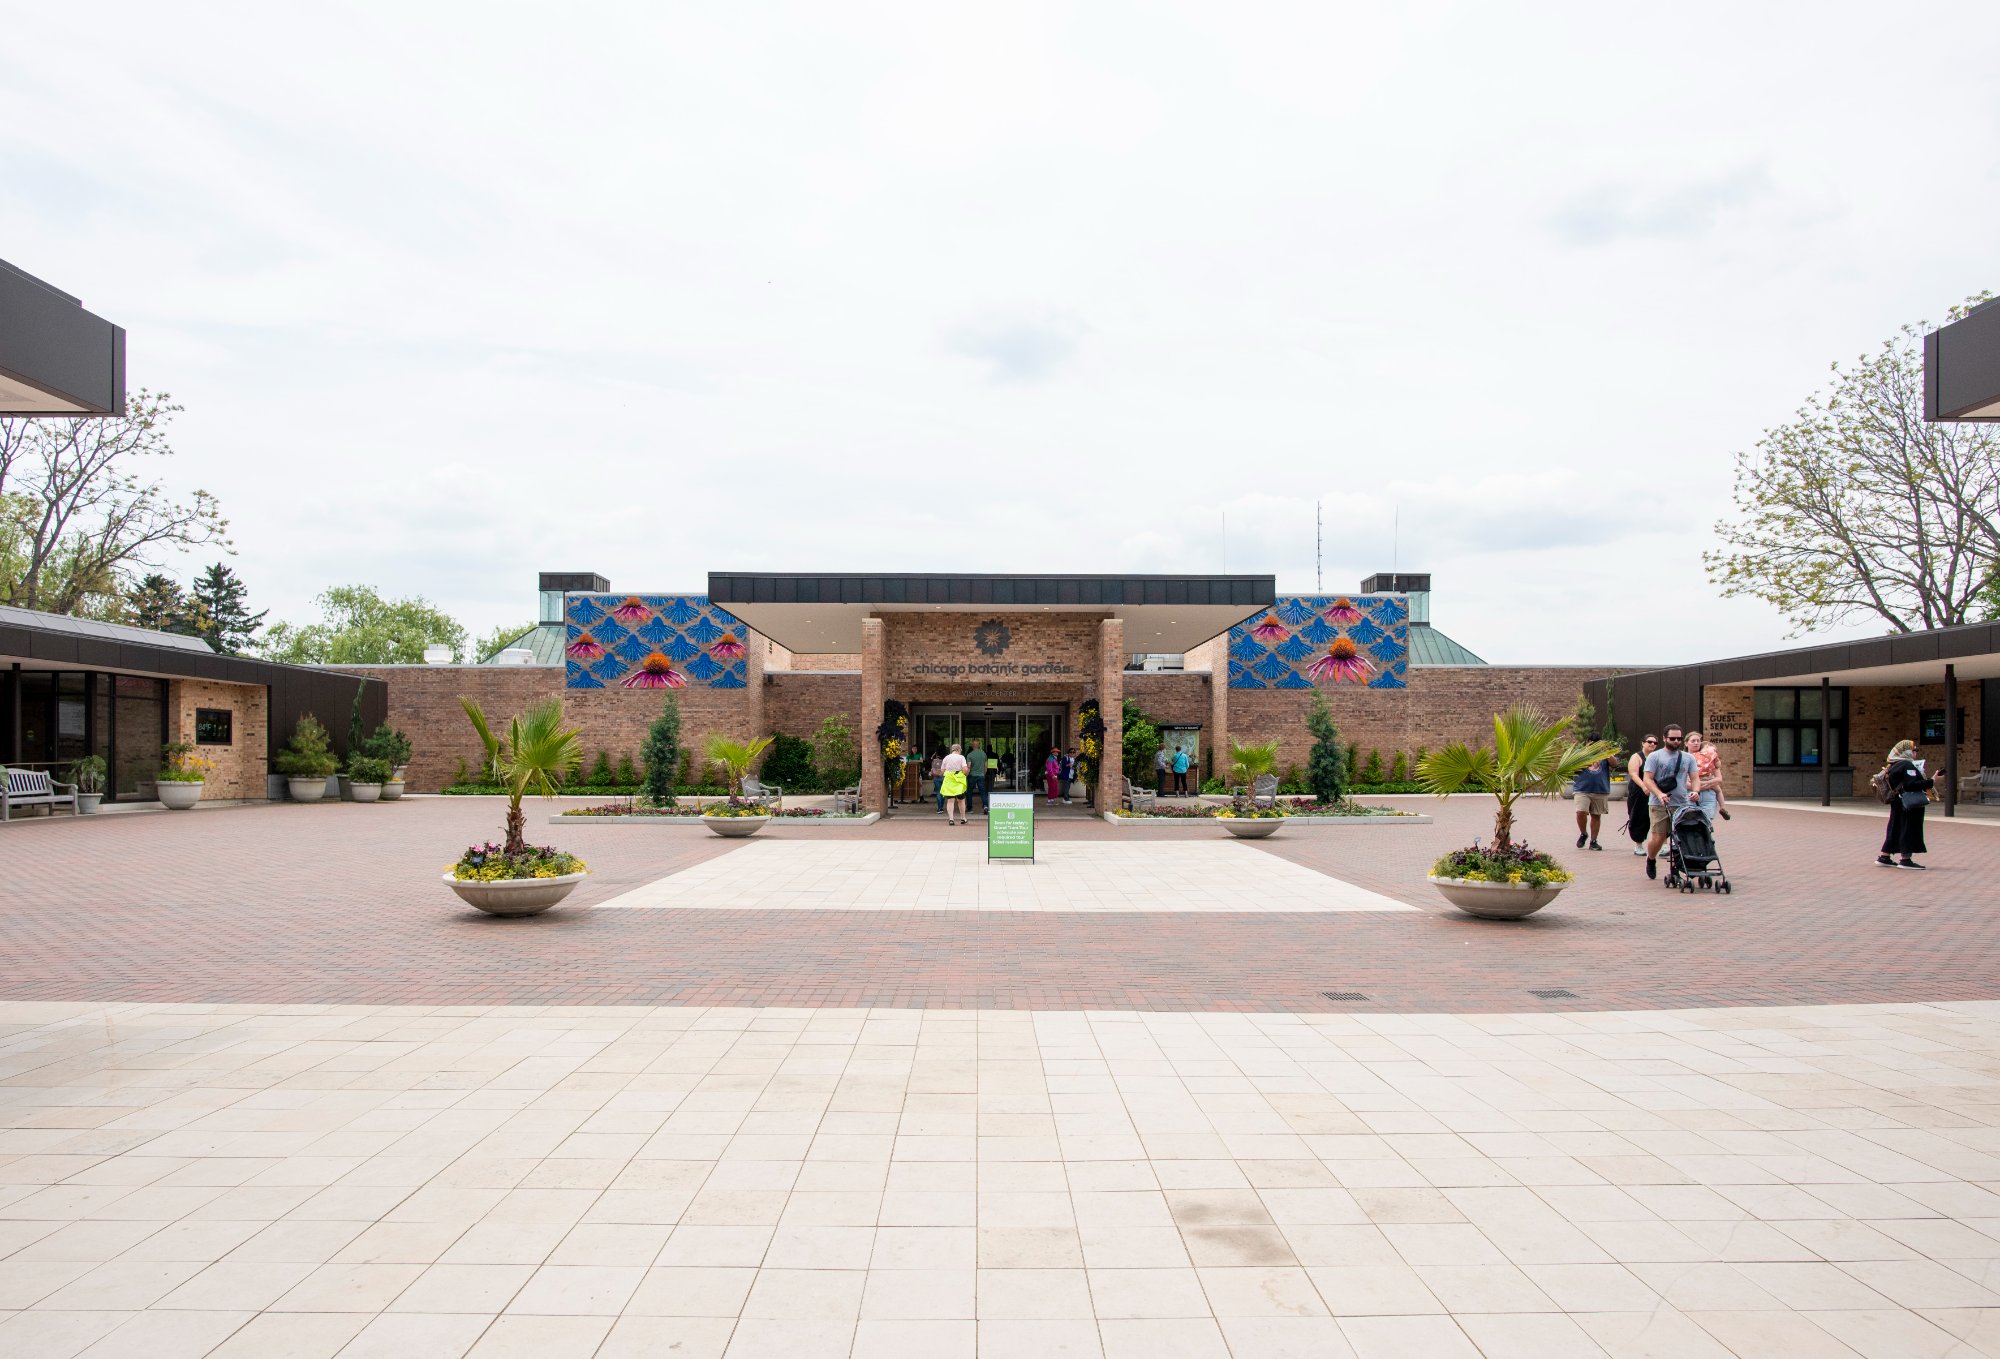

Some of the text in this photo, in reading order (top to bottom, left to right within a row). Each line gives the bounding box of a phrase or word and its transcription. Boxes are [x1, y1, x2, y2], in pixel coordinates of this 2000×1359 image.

[914, 663, 1071, 676] chicago botanic garden
[961, 690, 1017, 698] VISITOR CENTER
